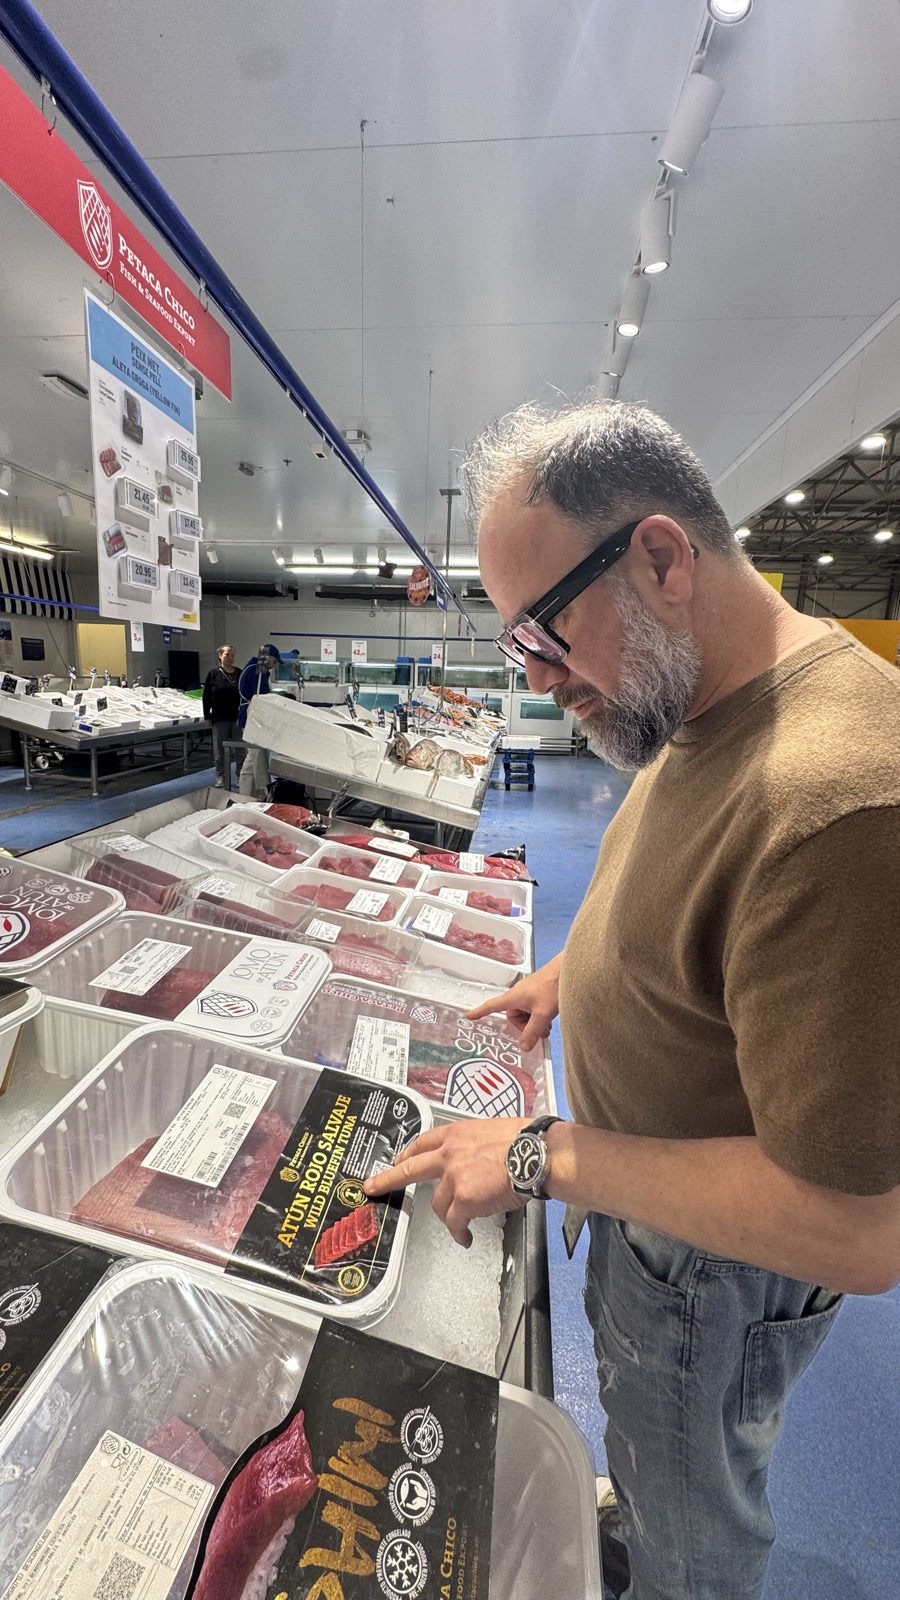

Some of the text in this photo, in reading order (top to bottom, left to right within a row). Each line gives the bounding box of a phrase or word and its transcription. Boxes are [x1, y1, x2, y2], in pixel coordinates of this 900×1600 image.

[118, 233, 194, 330] PETACA CHICO
[120, 261, 195, 346] FISH & SEAFOOD EXPORT
[112, 356, 130, 378] ALETA
[131, 341, 146, 364] PEIX
[132, 357, 161, 387] SENSE PELL
[134, 488, 149, 504] 21.45
[135, 564, 151, 578] 20.95
[229, 949, 270, 980] LOMO
[454, 1038, 522, 1068] LOMO
[288, 1130, 309, 1167] PETACA CHICO
[278, 1094, 351, 1248] ATÚN ROJO SALVAJE
[304, 1115, 357, 1229] WILD BLUEFIN TUNA
[387, 1462, 412, 1524] PREVENCIÓN DE ANISAKIASIS
[413, 1506, 434, 1527] PREVENTION
[22, 1528, 52, 1572] DESCONGELADO
[376, 1538, 388, 1582] PREVIAMENTE
[386, 1528, 411, 1542] CONGELADO
[415, 1541, 428, 1566] PRODUCT
[440, 1517, 456, 1600] A CHICO
[458, 1521, 468, 1566] EXPORT
